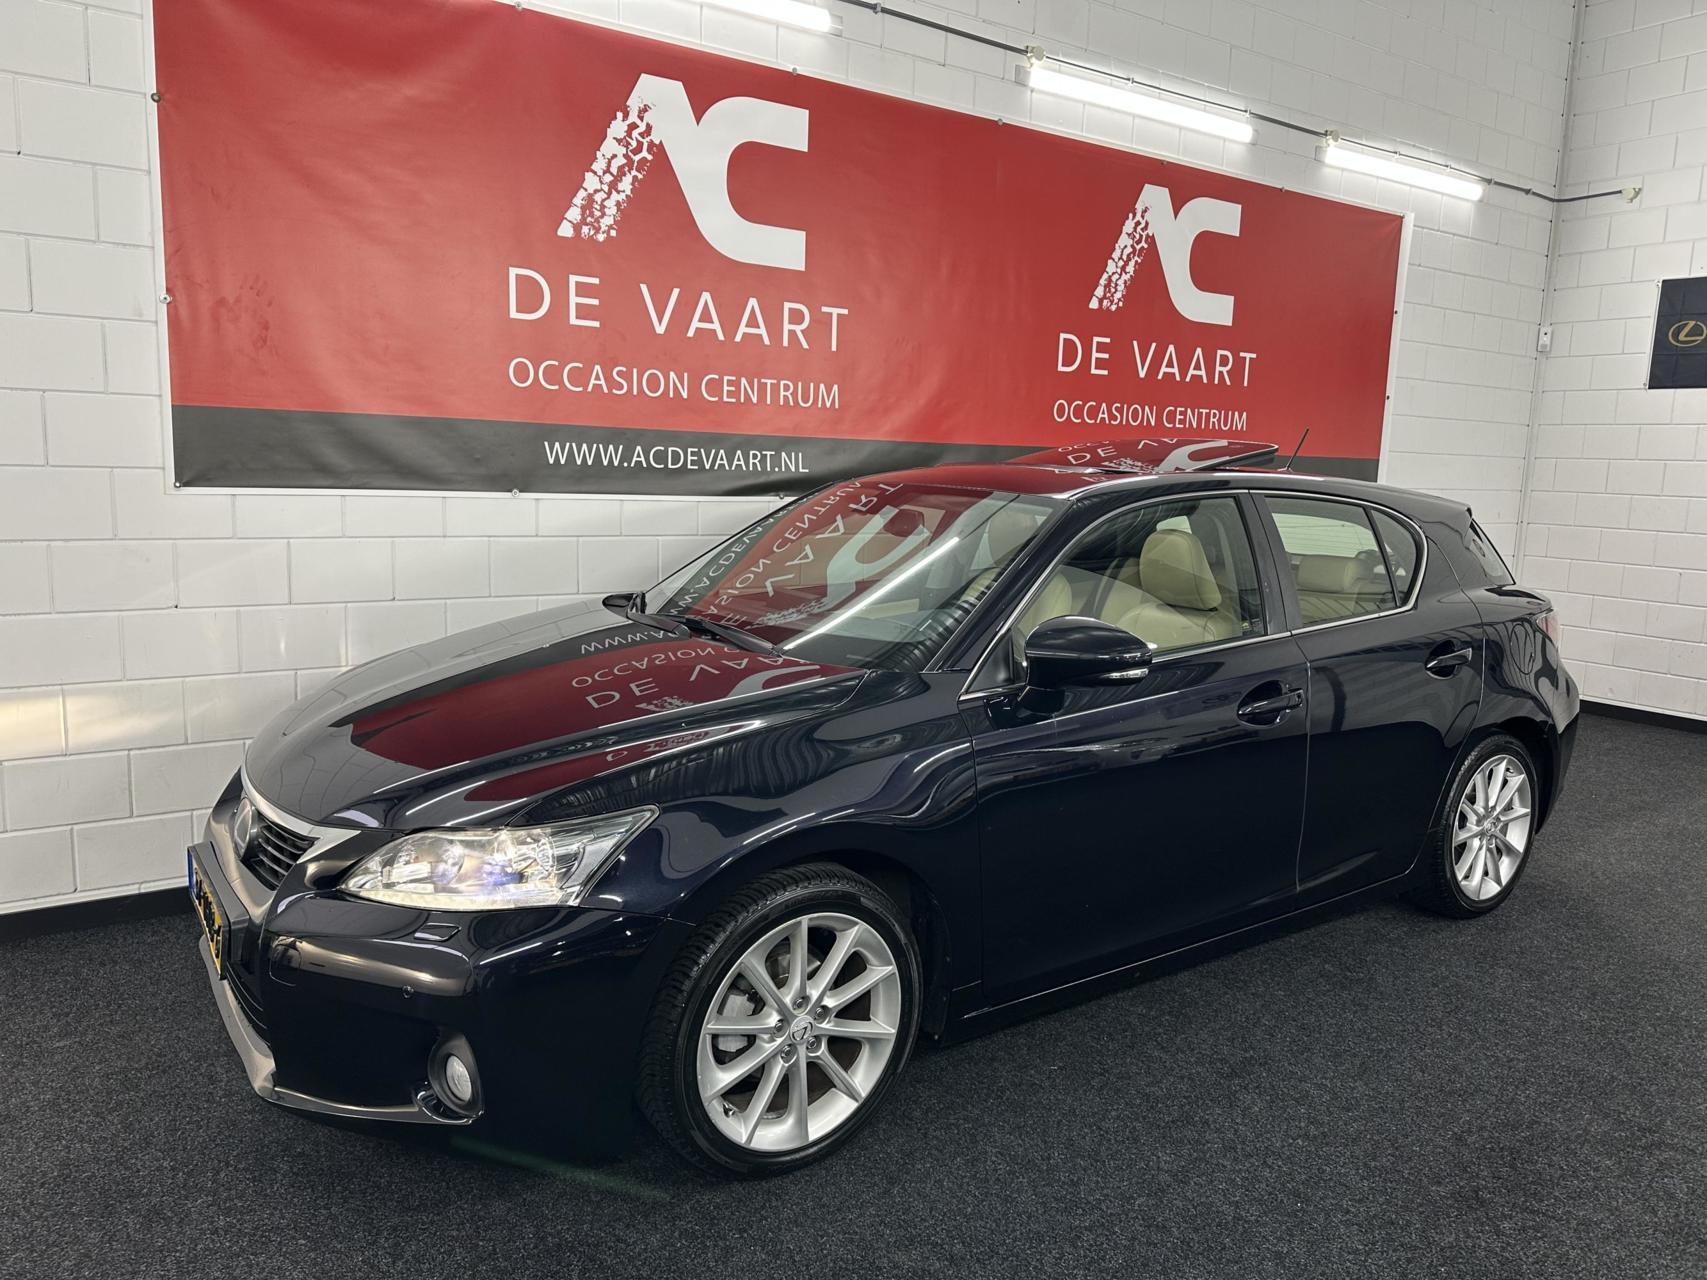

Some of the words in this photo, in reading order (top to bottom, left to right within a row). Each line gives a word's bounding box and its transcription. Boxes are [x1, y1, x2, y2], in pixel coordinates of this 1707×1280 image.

[557, 73, 809, 271] AC
[1088, 183, 1242, 326] AC
[508, 266, 600, 328] DE
[639, 283, 849, 352] VAART
[508, 357, 689, 399] OCCASION
[701, 374, 840, 409] CENTRUM
[1057, 332, 1111, 375] DE
[1132, 340, 1257, 387] VAART
[1053, 399, 1156, 427] OCCASION
[1163, 406, 1247, 431] CENTRUM
[543, 441, 810, 473] WWW.ACDEVAART.NL
